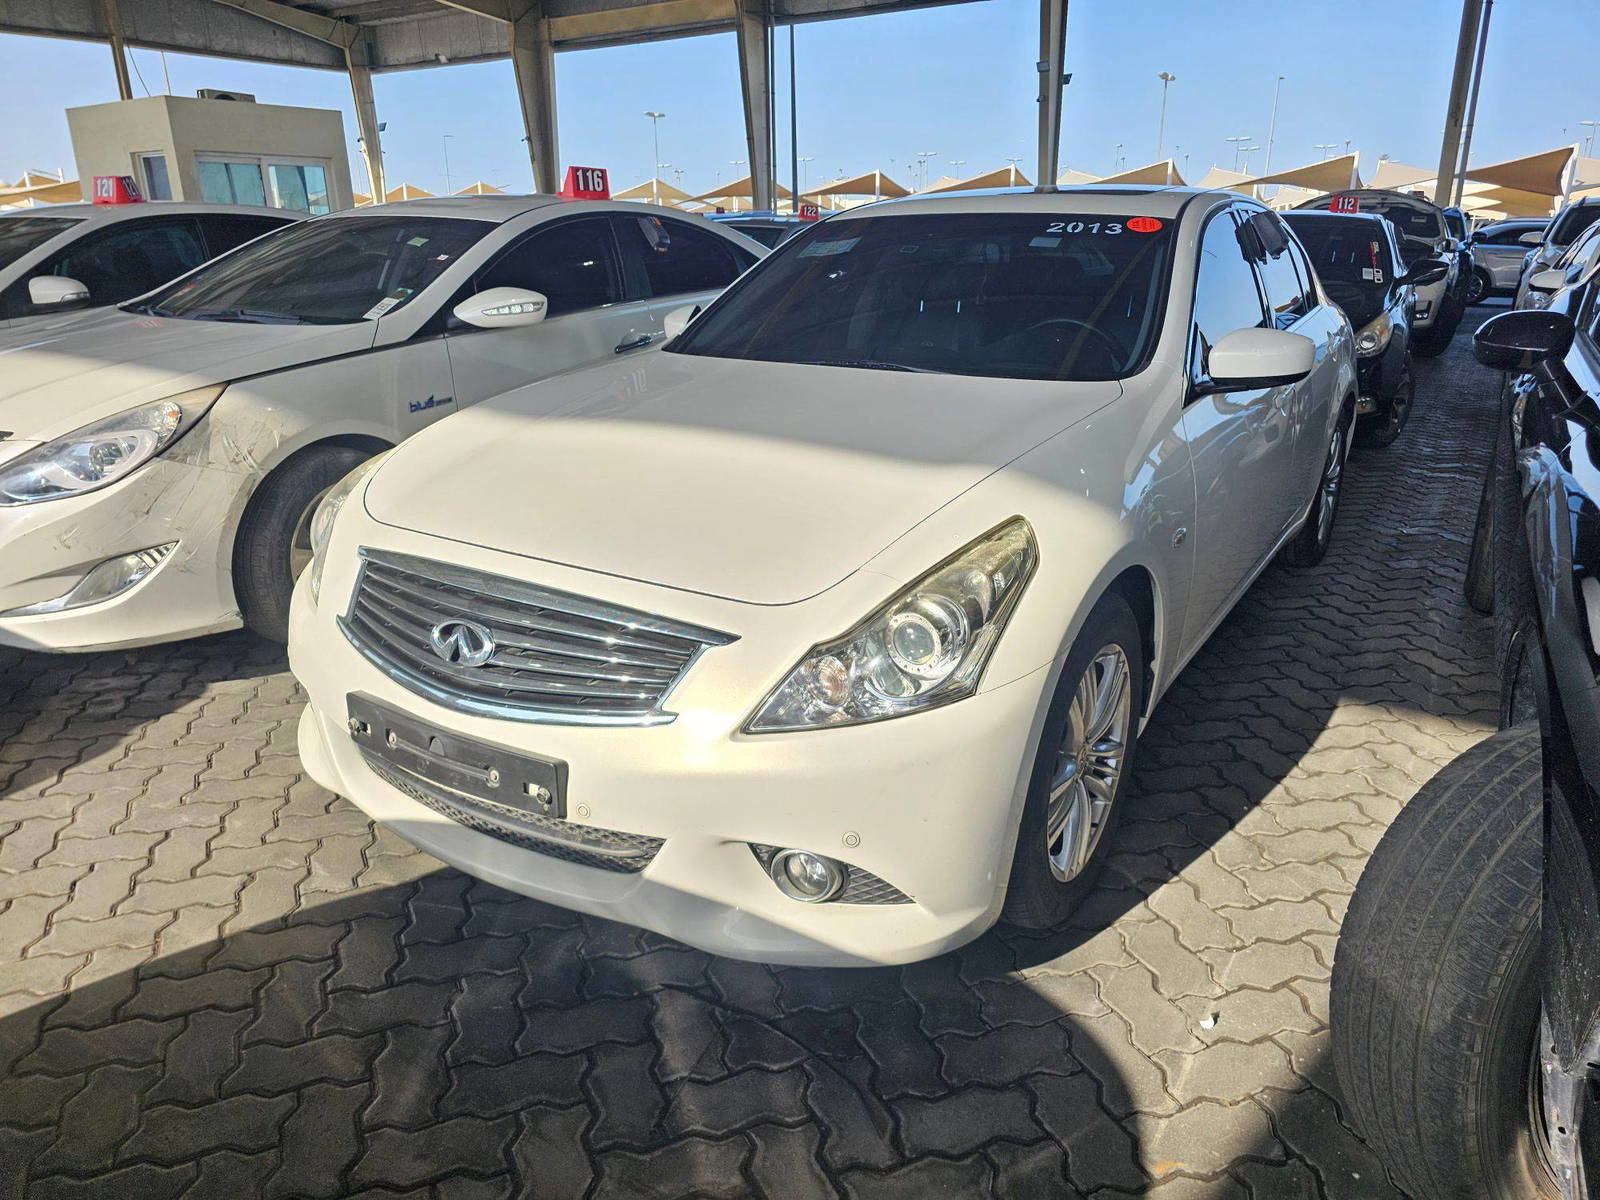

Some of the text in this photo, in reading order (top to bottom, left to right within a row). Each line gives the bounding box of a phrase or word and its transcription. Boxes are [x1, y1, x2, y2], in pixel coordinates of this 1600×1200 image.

[576, 168, 604, 192] 116
[96, 178, 114, 198] 121
[1338, 197, 1355, 210] 112
[803, 206, 817, 217] 122
[1045, 221, 1123, 235] 2013
